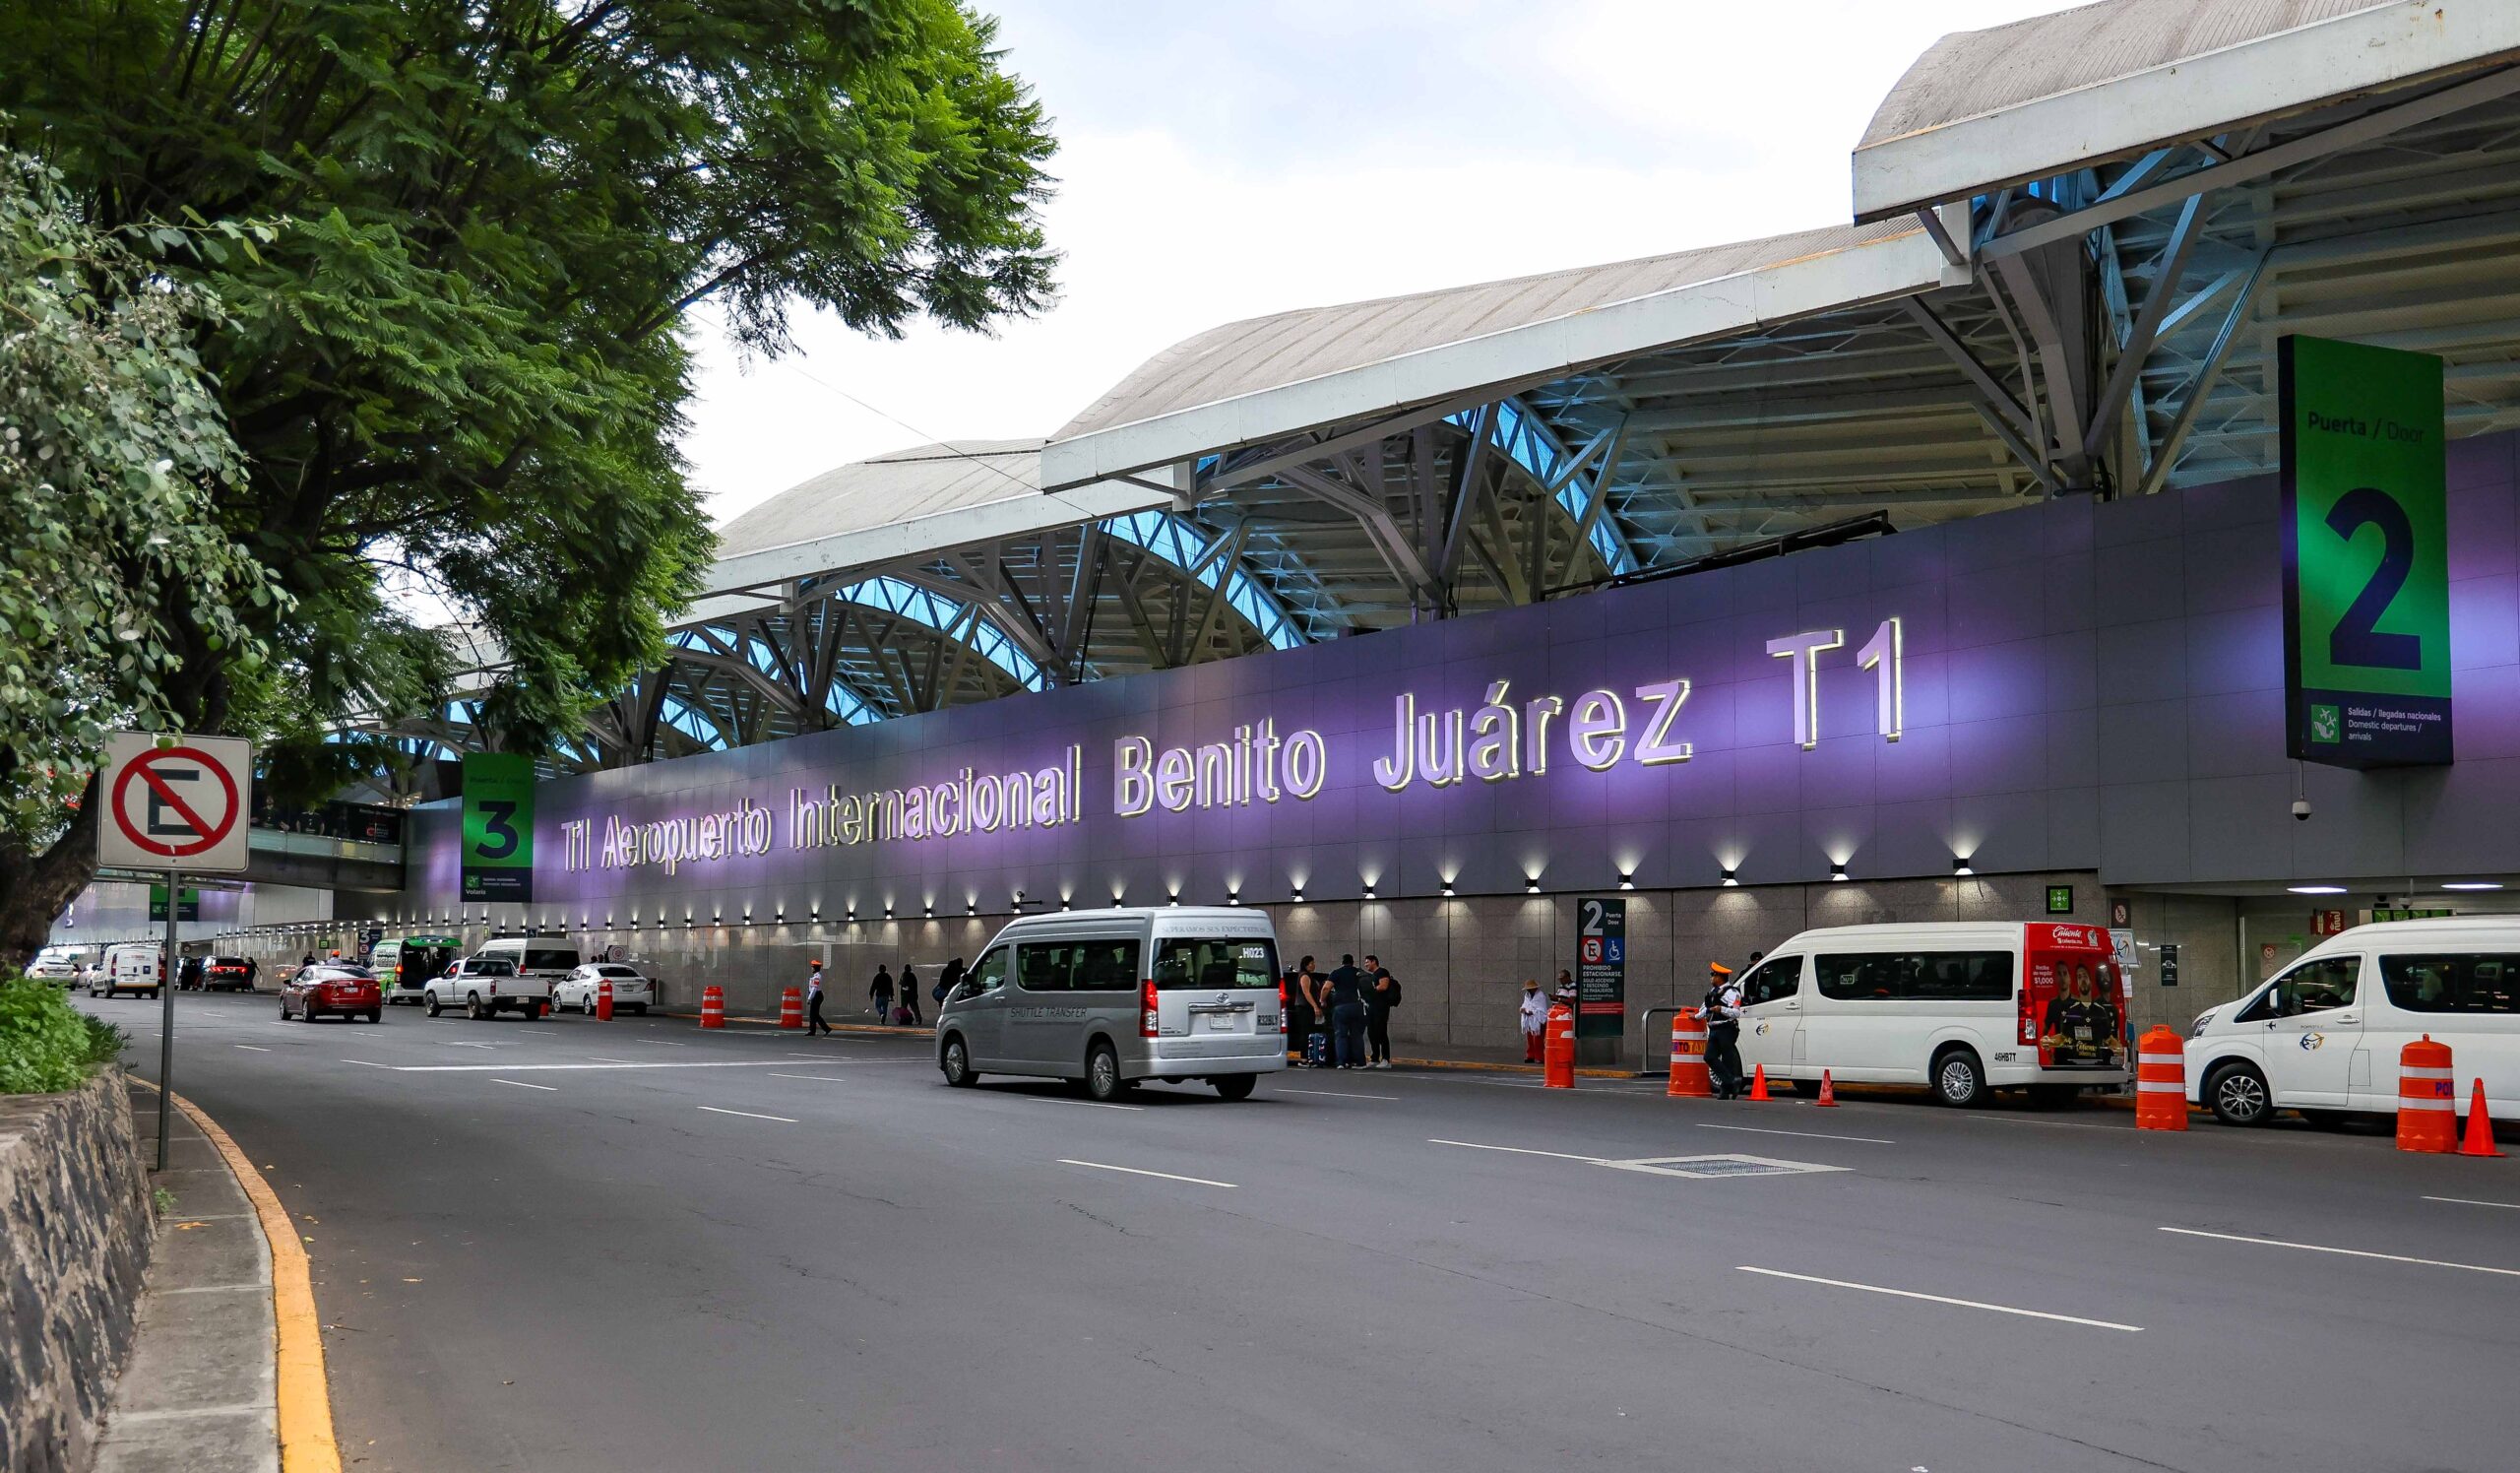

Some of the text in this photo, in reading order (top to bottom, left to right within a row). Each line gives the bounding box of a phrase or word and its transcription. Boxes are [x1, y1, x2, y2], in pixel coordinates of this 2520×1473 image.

[2307, 411, 2367, 437] Puerta
[2387, 421, 2426, 443] Door
[2324, 487, 2422, 671] 2
[2348, 707, 2371, 717] Salidas
[2378, 709, 2406, 720] llegadas
[2407, 711, 2441, 721] nacionales
[2348, 720, 2379, 730] Domestic
[2381, 722, 2417, 732] departures
[2348, 732, 2372, 741] arrivals
[600, 798, 772, 875] Aeropuerto
[789, 743, 1081, 850] Internacional
[1113, 717, 1326, 818] Benito
[1372, 678, 1693, 792] Juárez
[1765, 617, 1907, 751] T1
[475, 801, 519, 859] 3
[1584, 900, 1603, 935] 2
[359, 929, 369, 943] 3
[2052, 926, 2082, 938] Caliente
[1242, 947, 1264, 958] H023
[1011, 1007, 1087, 1018] SHUTTLE TRANSFER
